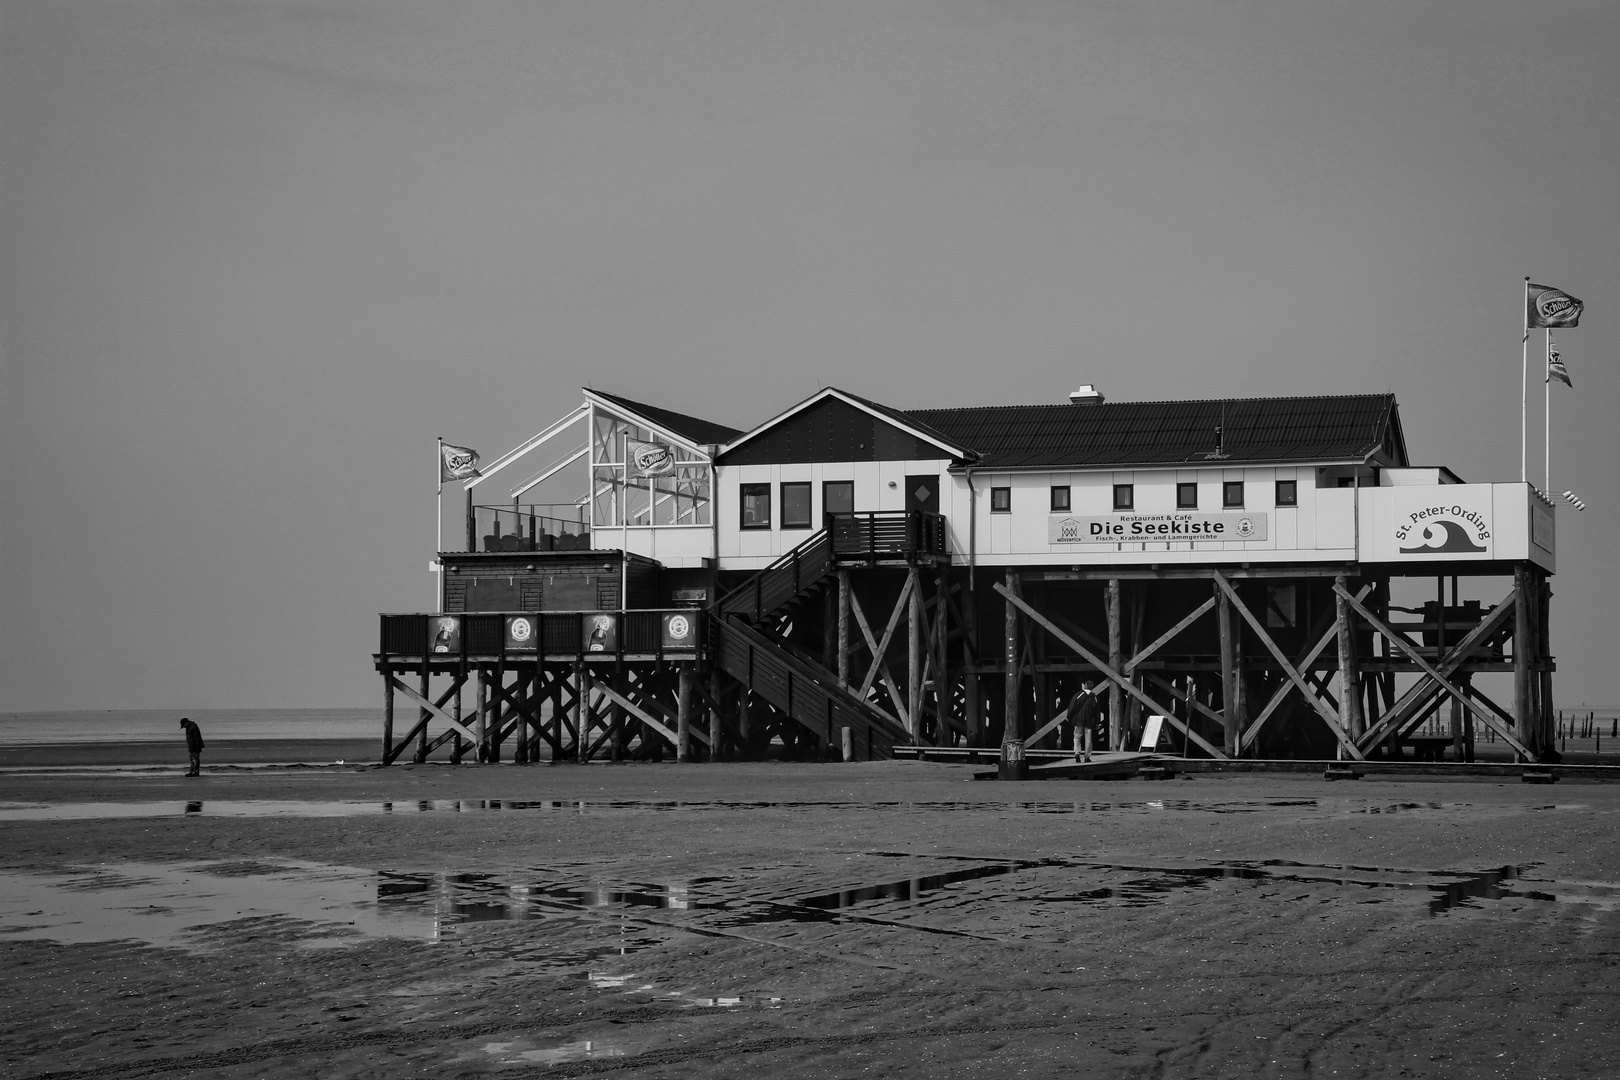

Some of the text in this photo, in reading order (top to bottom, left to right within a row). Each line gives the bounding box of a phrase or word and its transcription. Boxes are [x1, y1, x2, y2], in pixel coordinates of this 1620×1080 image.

[1174, 513, 1193, 521] Café
[1090, 521, 1124, 535] Die
[1131, 520, 1225, 535] Seekiste
[1395, 505, 1491, 541] St. Peter-Ording
[1168, 533, 1218, 541] Lammgerichte
